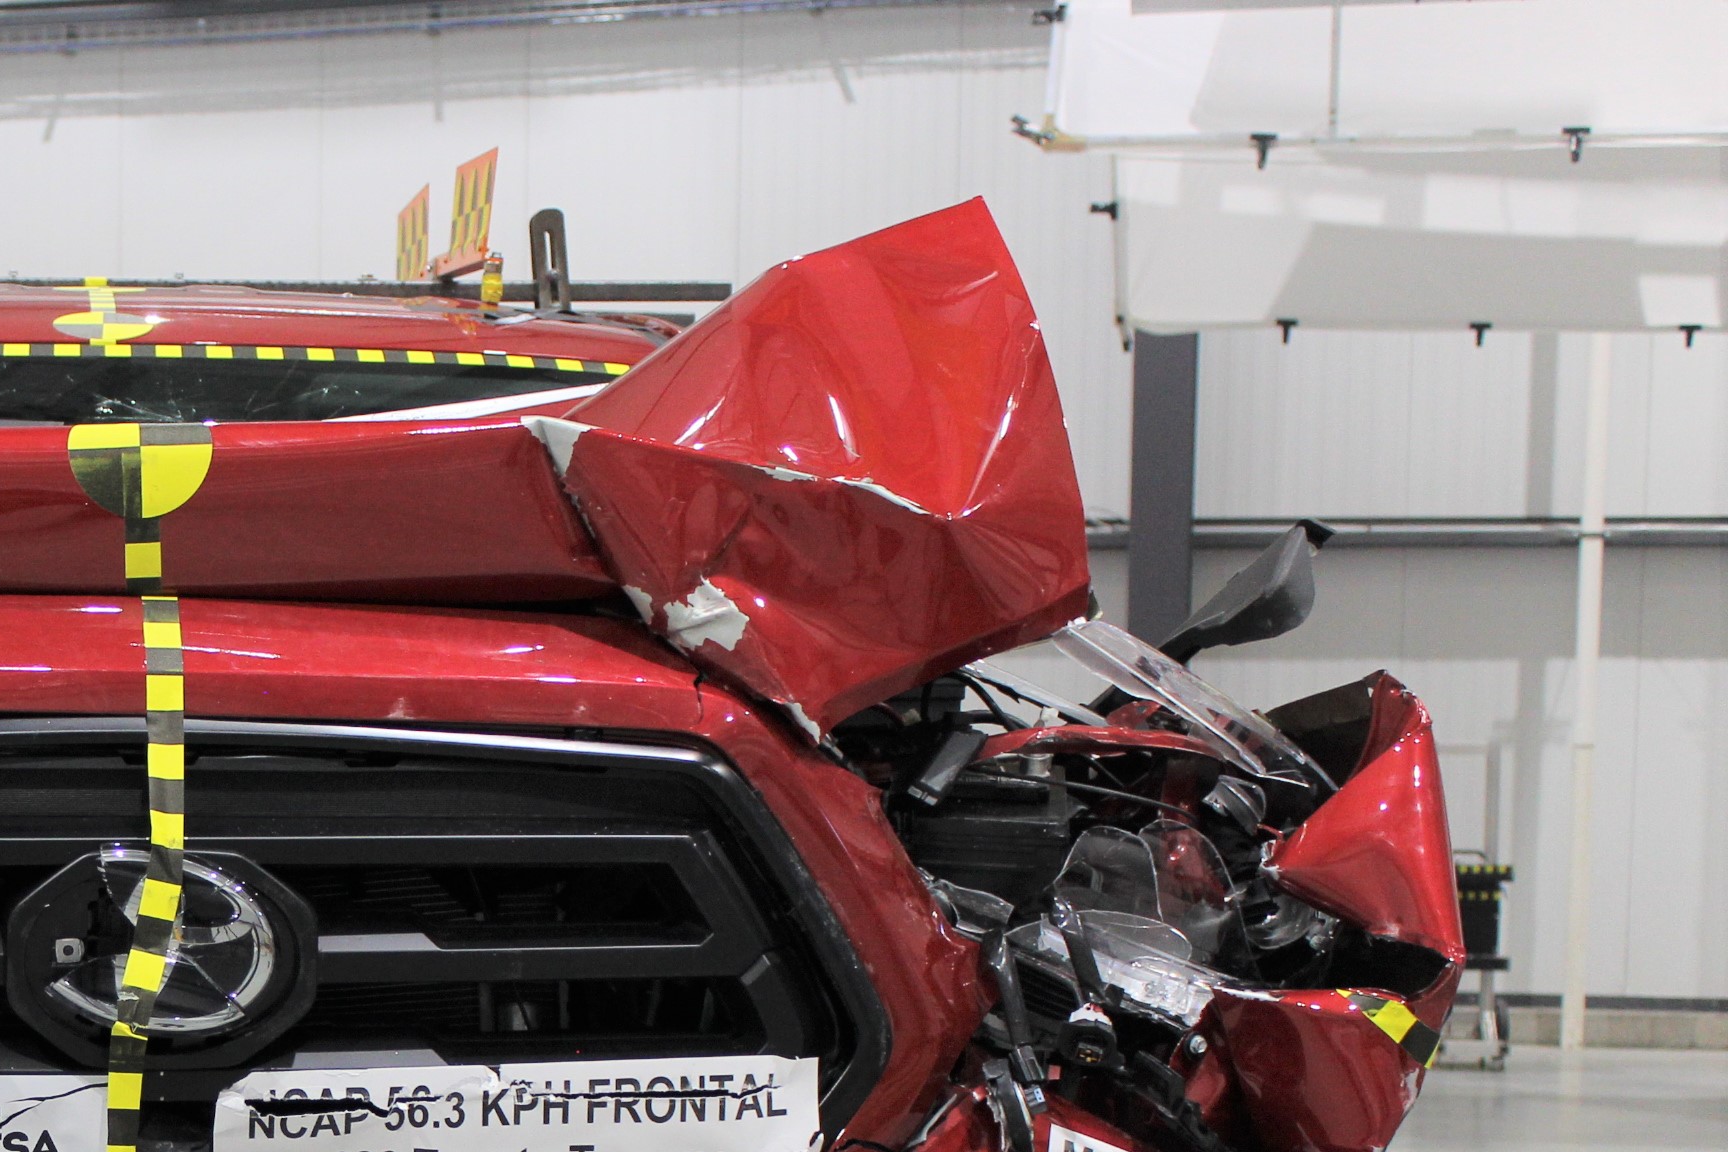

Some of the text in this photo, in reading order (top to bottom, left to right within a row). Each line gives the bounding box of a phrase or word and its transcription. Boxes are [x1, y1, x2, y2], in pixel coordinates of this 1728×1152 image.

[248, 1087, 371, 1139] NCAP
[384, 1085, 466, 1131] 56.3
[586, 1073, 788, 1124] FRONTAL
